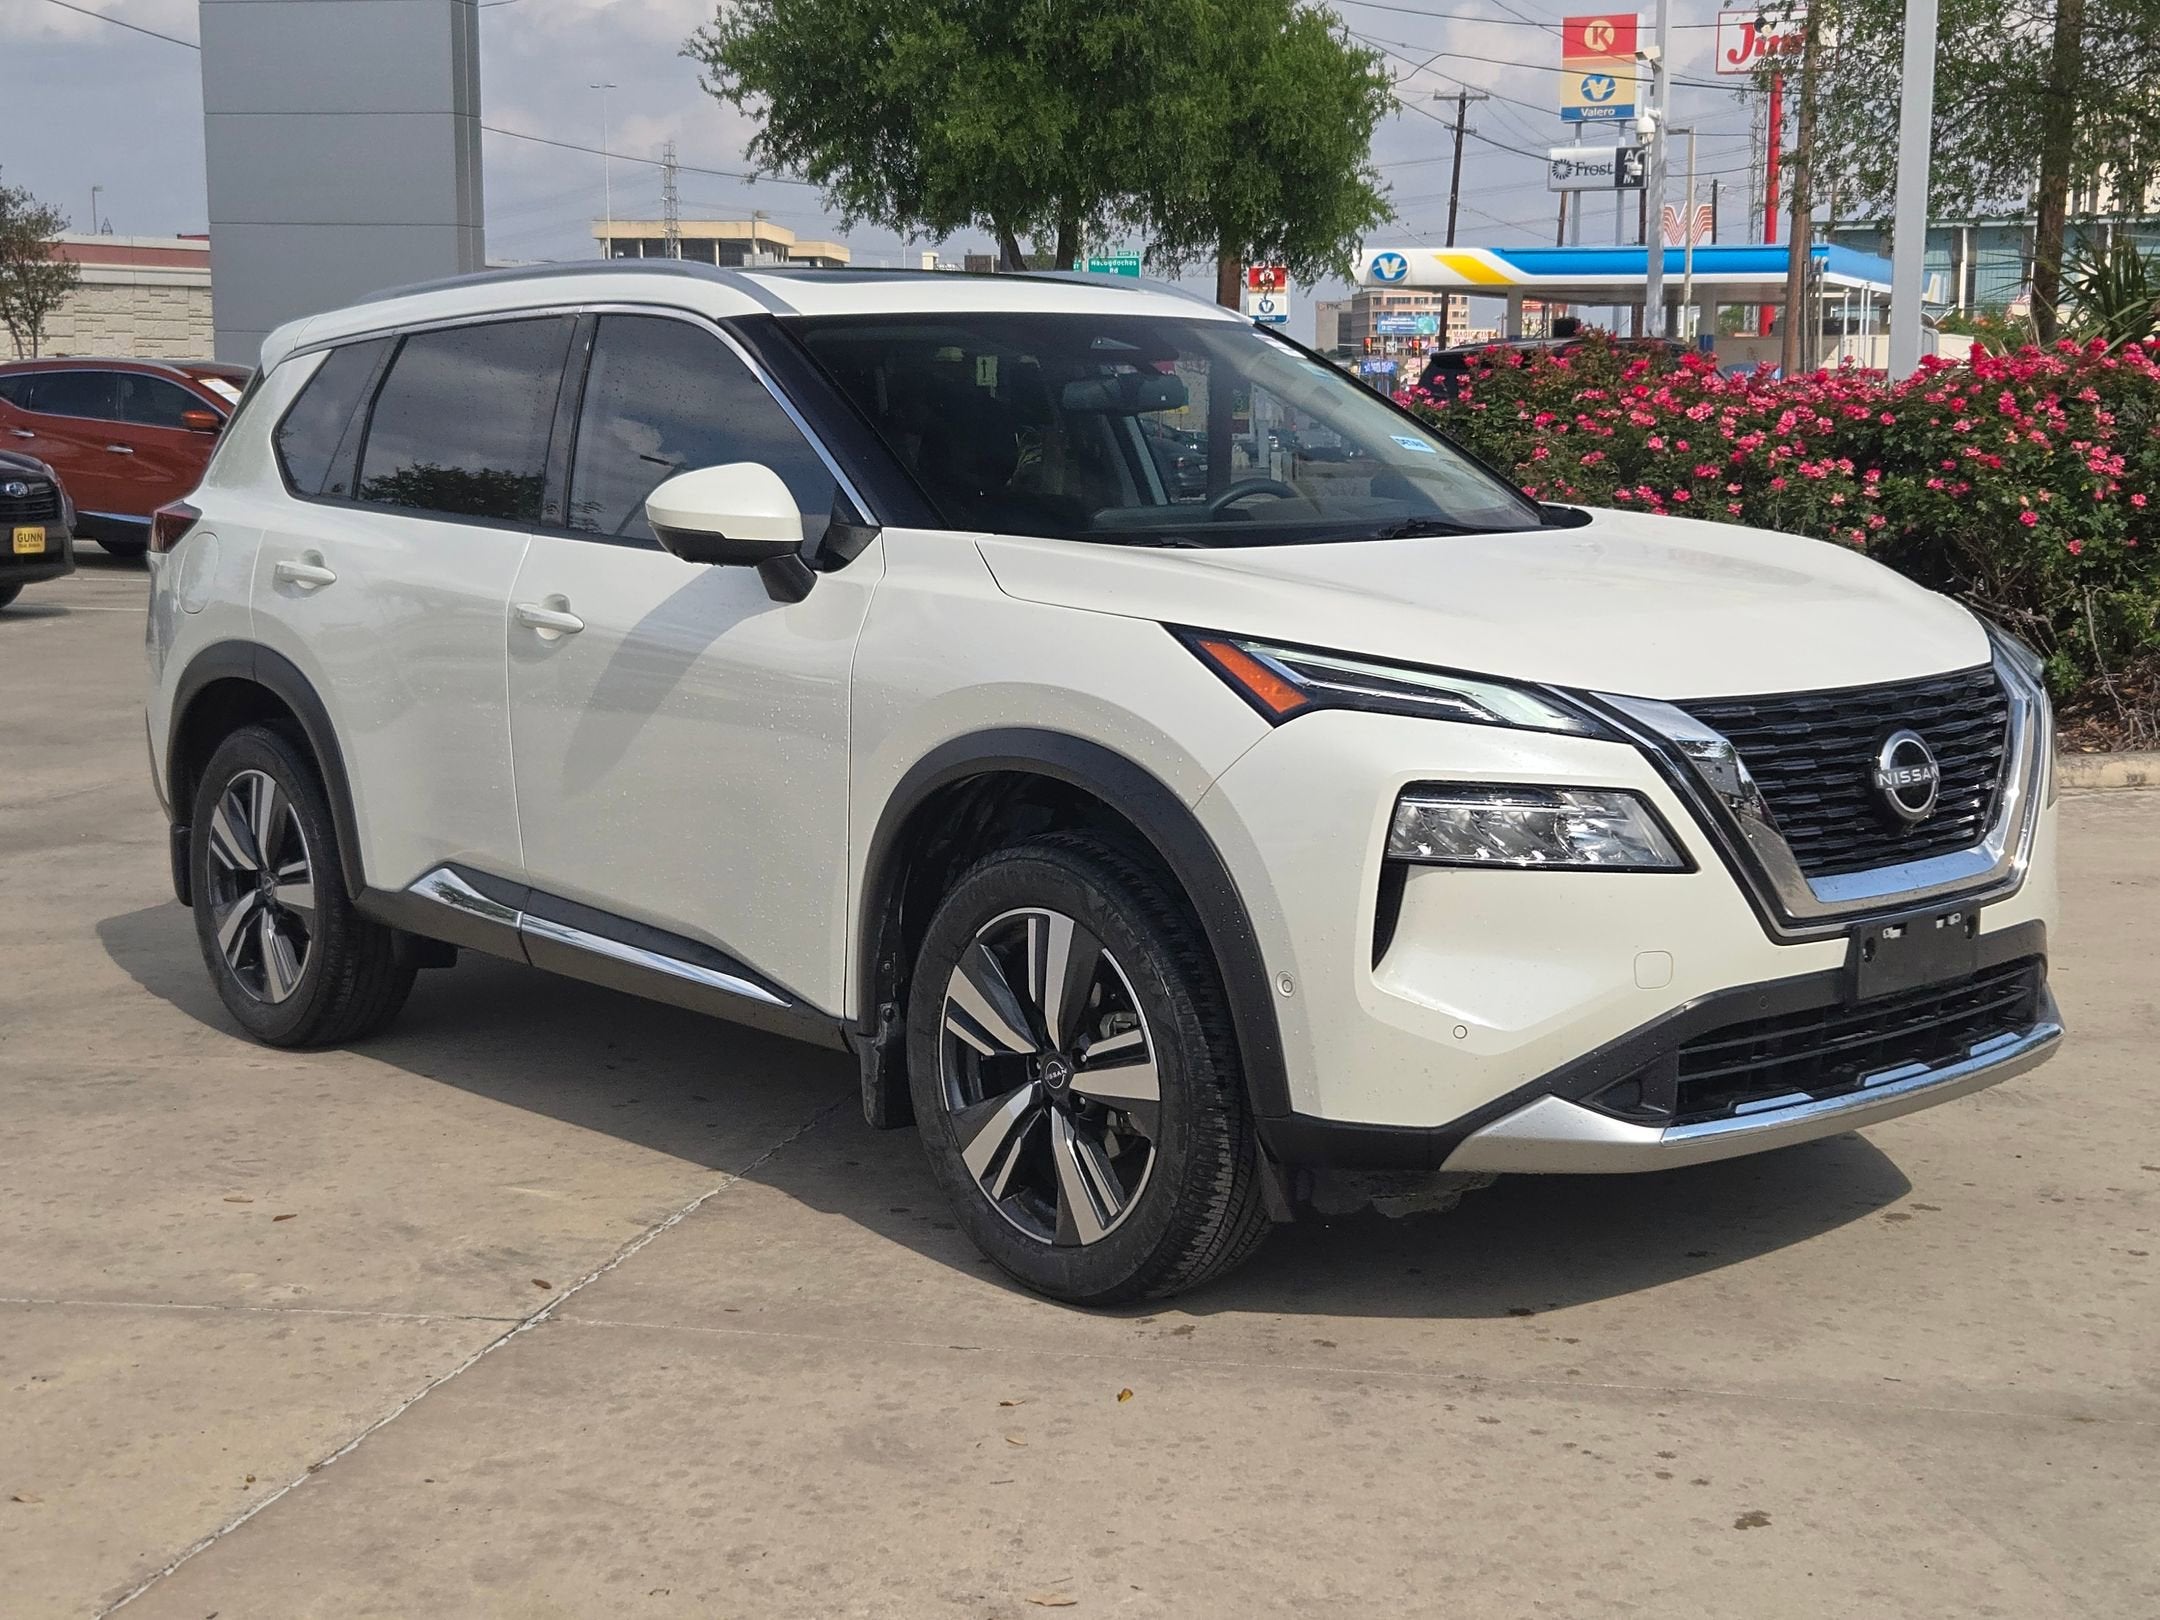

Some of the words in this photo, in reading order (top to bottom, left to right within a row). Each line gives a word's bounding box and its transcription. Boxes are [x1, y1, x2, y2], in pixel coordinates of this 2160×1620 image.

[1580, 106, 1616, 117] Valero
[1574, 161, 1615, 177] Frost
[1090, 259, 1137, 268] Nacogdoches
[16, 532, 43, 543] GUNN
[1878, 766, 1939, 786] NISSAN
